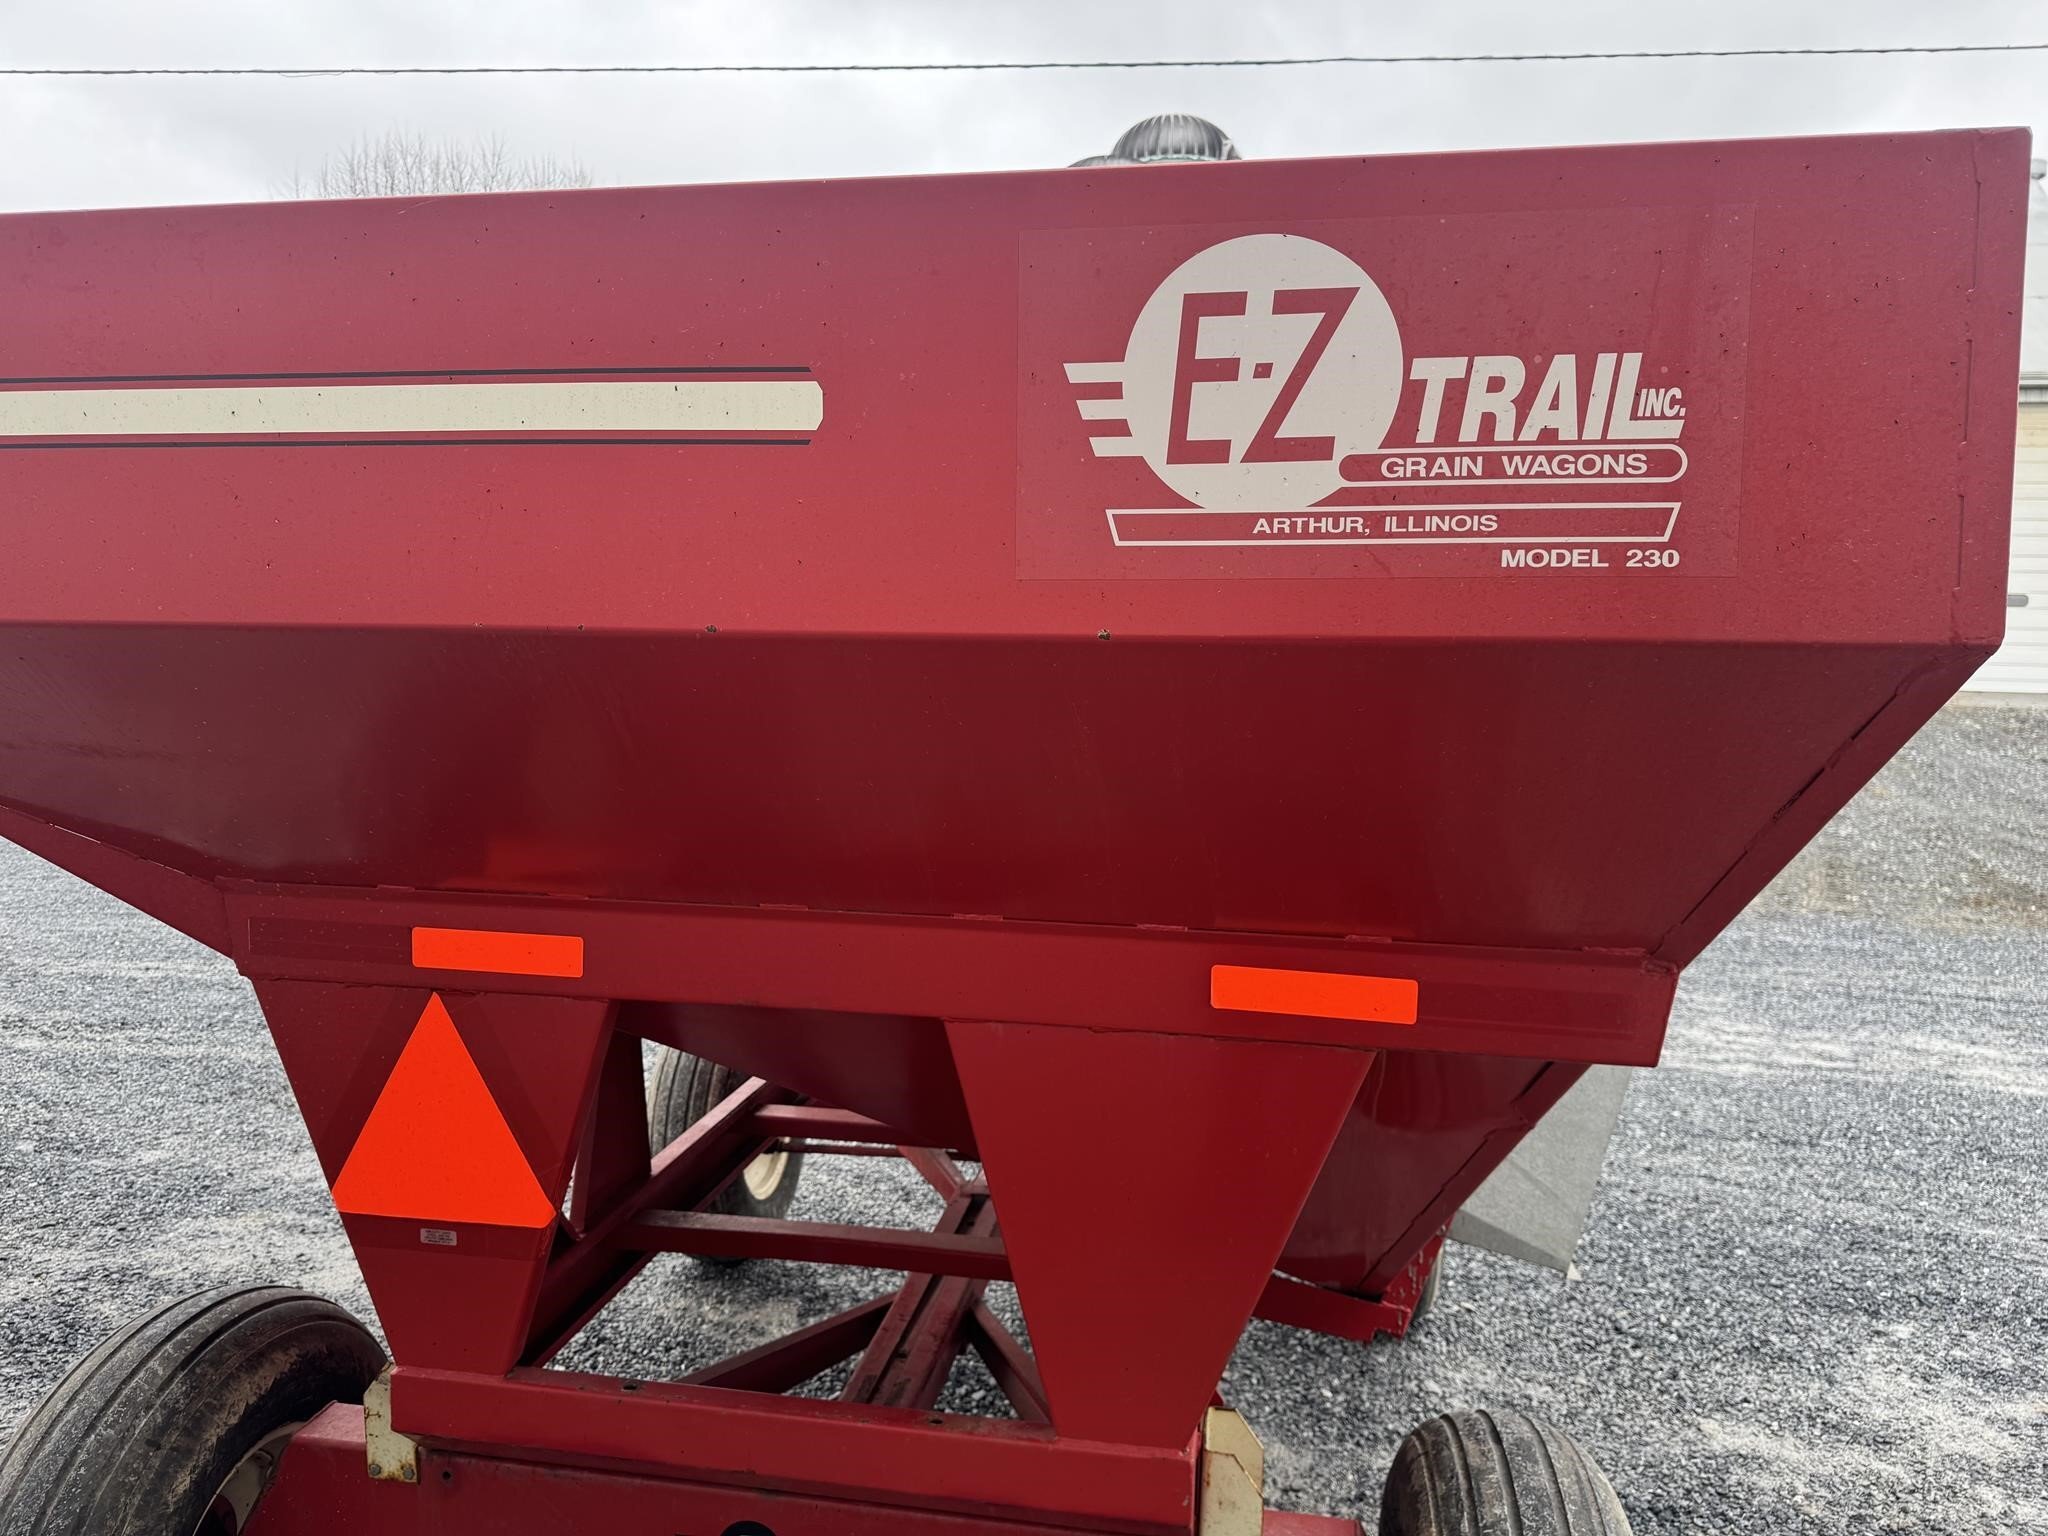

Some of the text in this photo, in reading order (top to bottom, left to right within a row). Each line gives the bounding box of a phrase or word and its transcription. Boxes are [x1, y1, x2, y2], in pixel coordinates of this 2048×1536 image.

[1409, 352, 1687, 444] TRAIL INC.
[1380, 453, 1648, 479] GRAIN WAGONS
[1252, 514, 1498, 536] ARTHUR, ILLINOIS
[1501, 548, 1680, 568] MODEL 230
